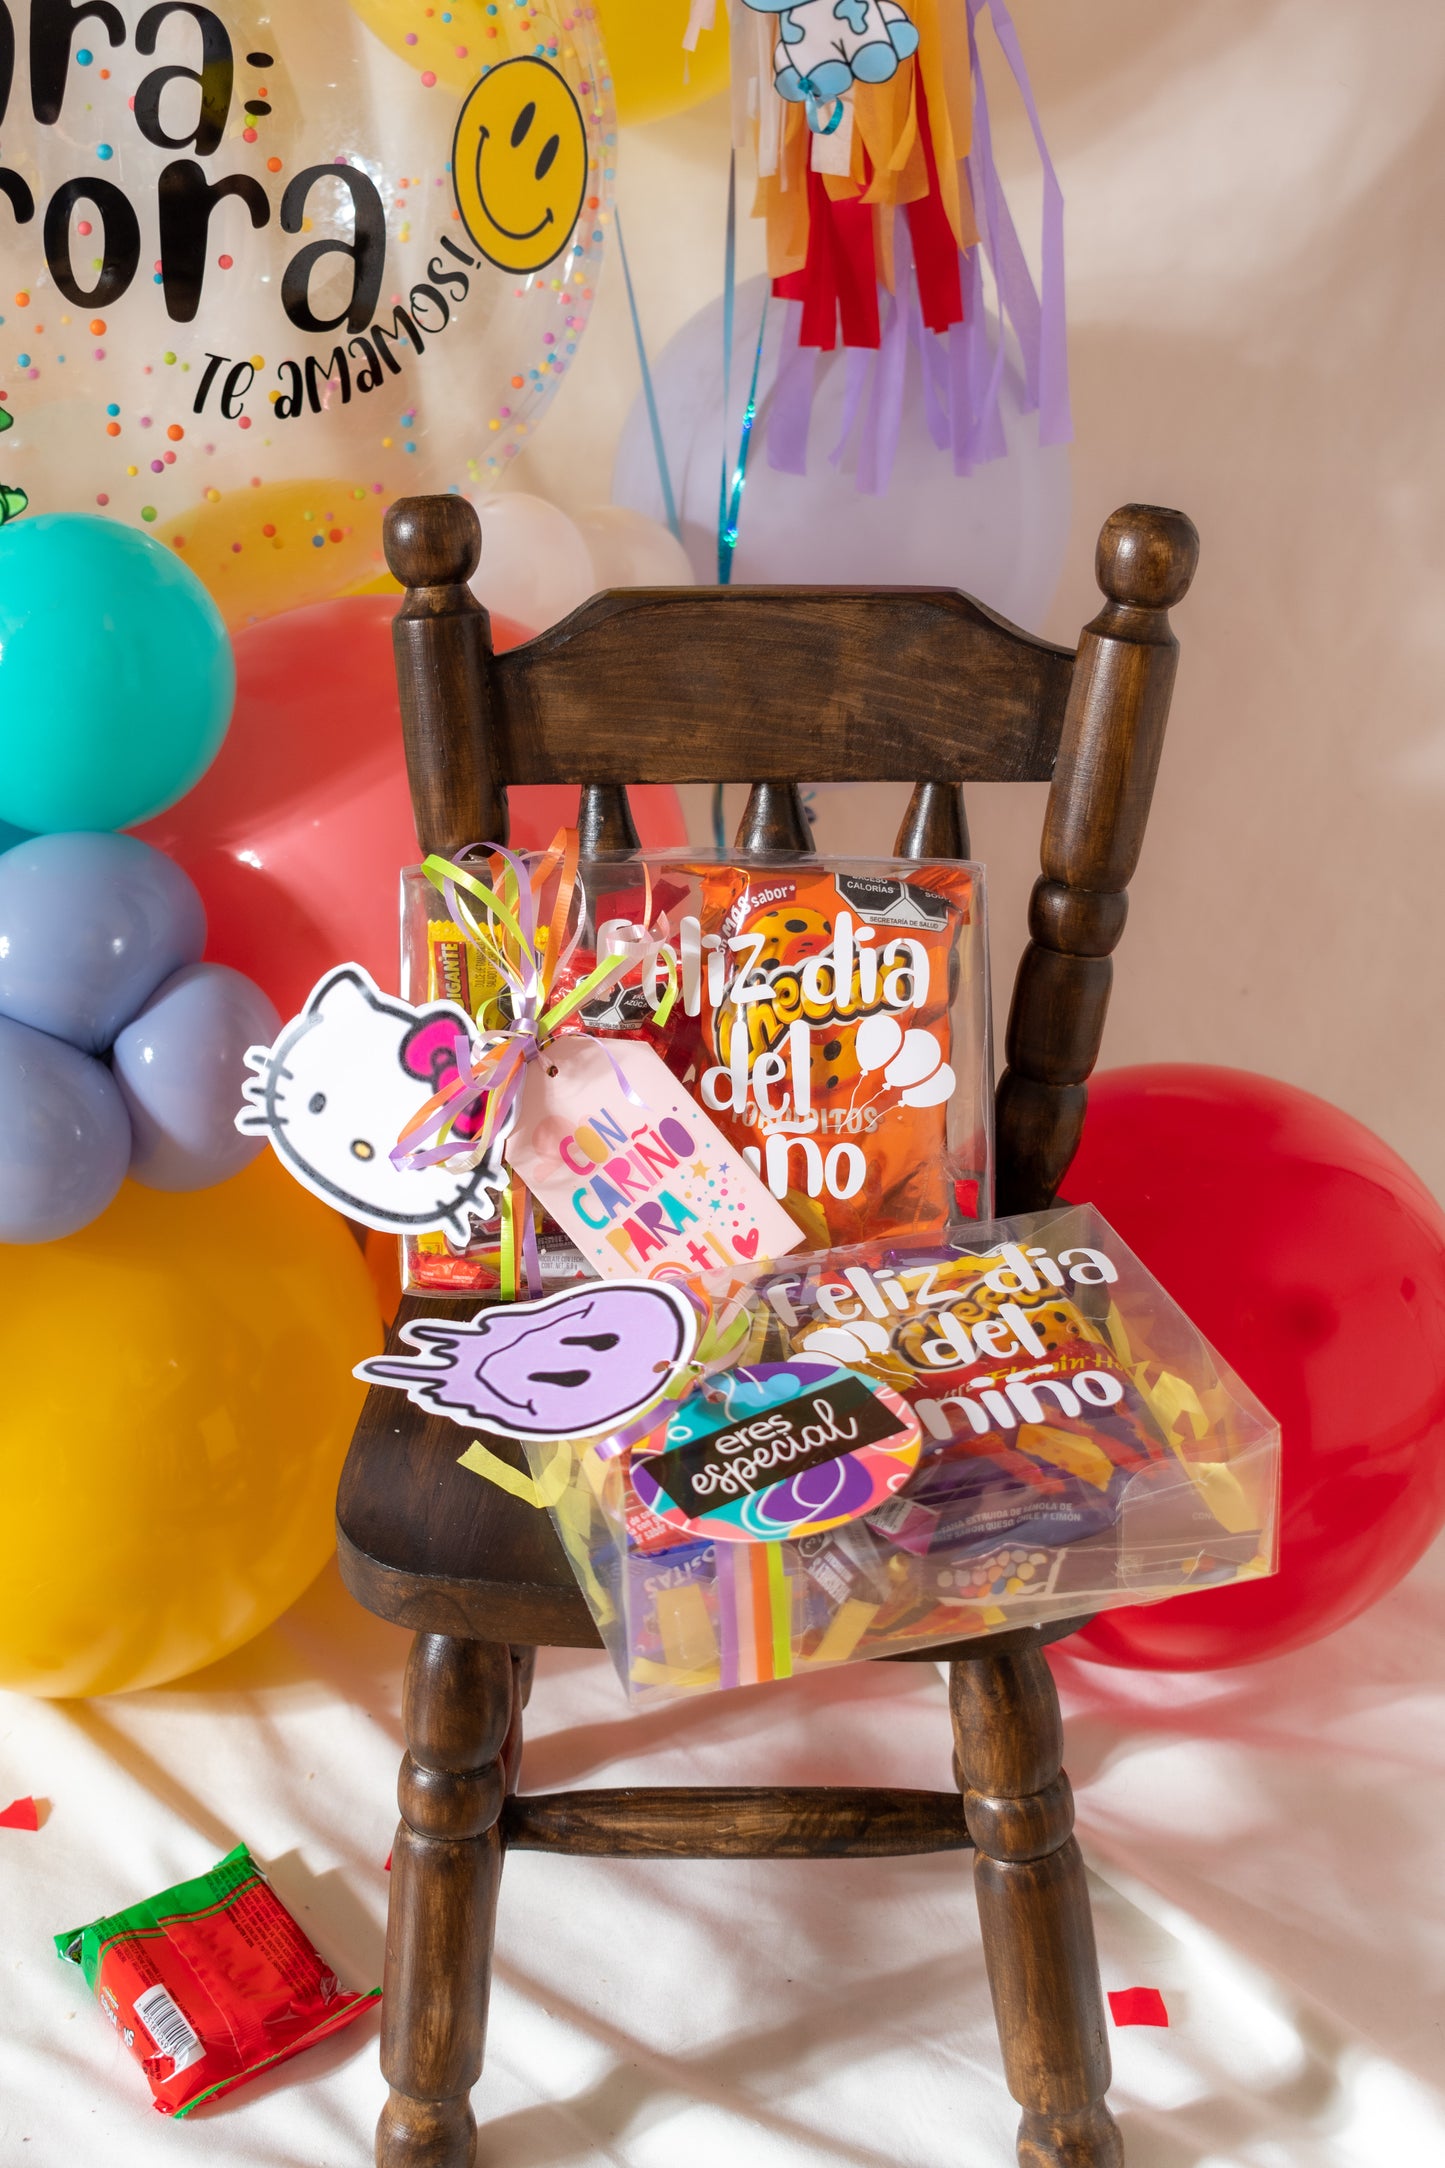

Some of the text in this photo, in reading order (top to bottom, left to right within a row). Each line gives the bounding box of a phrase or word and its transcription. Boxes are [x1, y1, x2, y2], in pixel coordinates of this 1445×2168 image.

[846, 881, 895, 894] CALORÍAS
[700, 1020, 811, 1117] del
[559, 1107, 628, 1176] CON
[572, 1117, 695, 1230] CARIÑO
[605, 1189, 699, 1273] PARA
[767, 1266, 966, 1328] Feliz
[921, 1303, 1047, 1366] del
[715, 1414, 793, 1455] eres
[914, 1363, 1125, 1441] niño
[691, 1398, 860, 1496] especial
